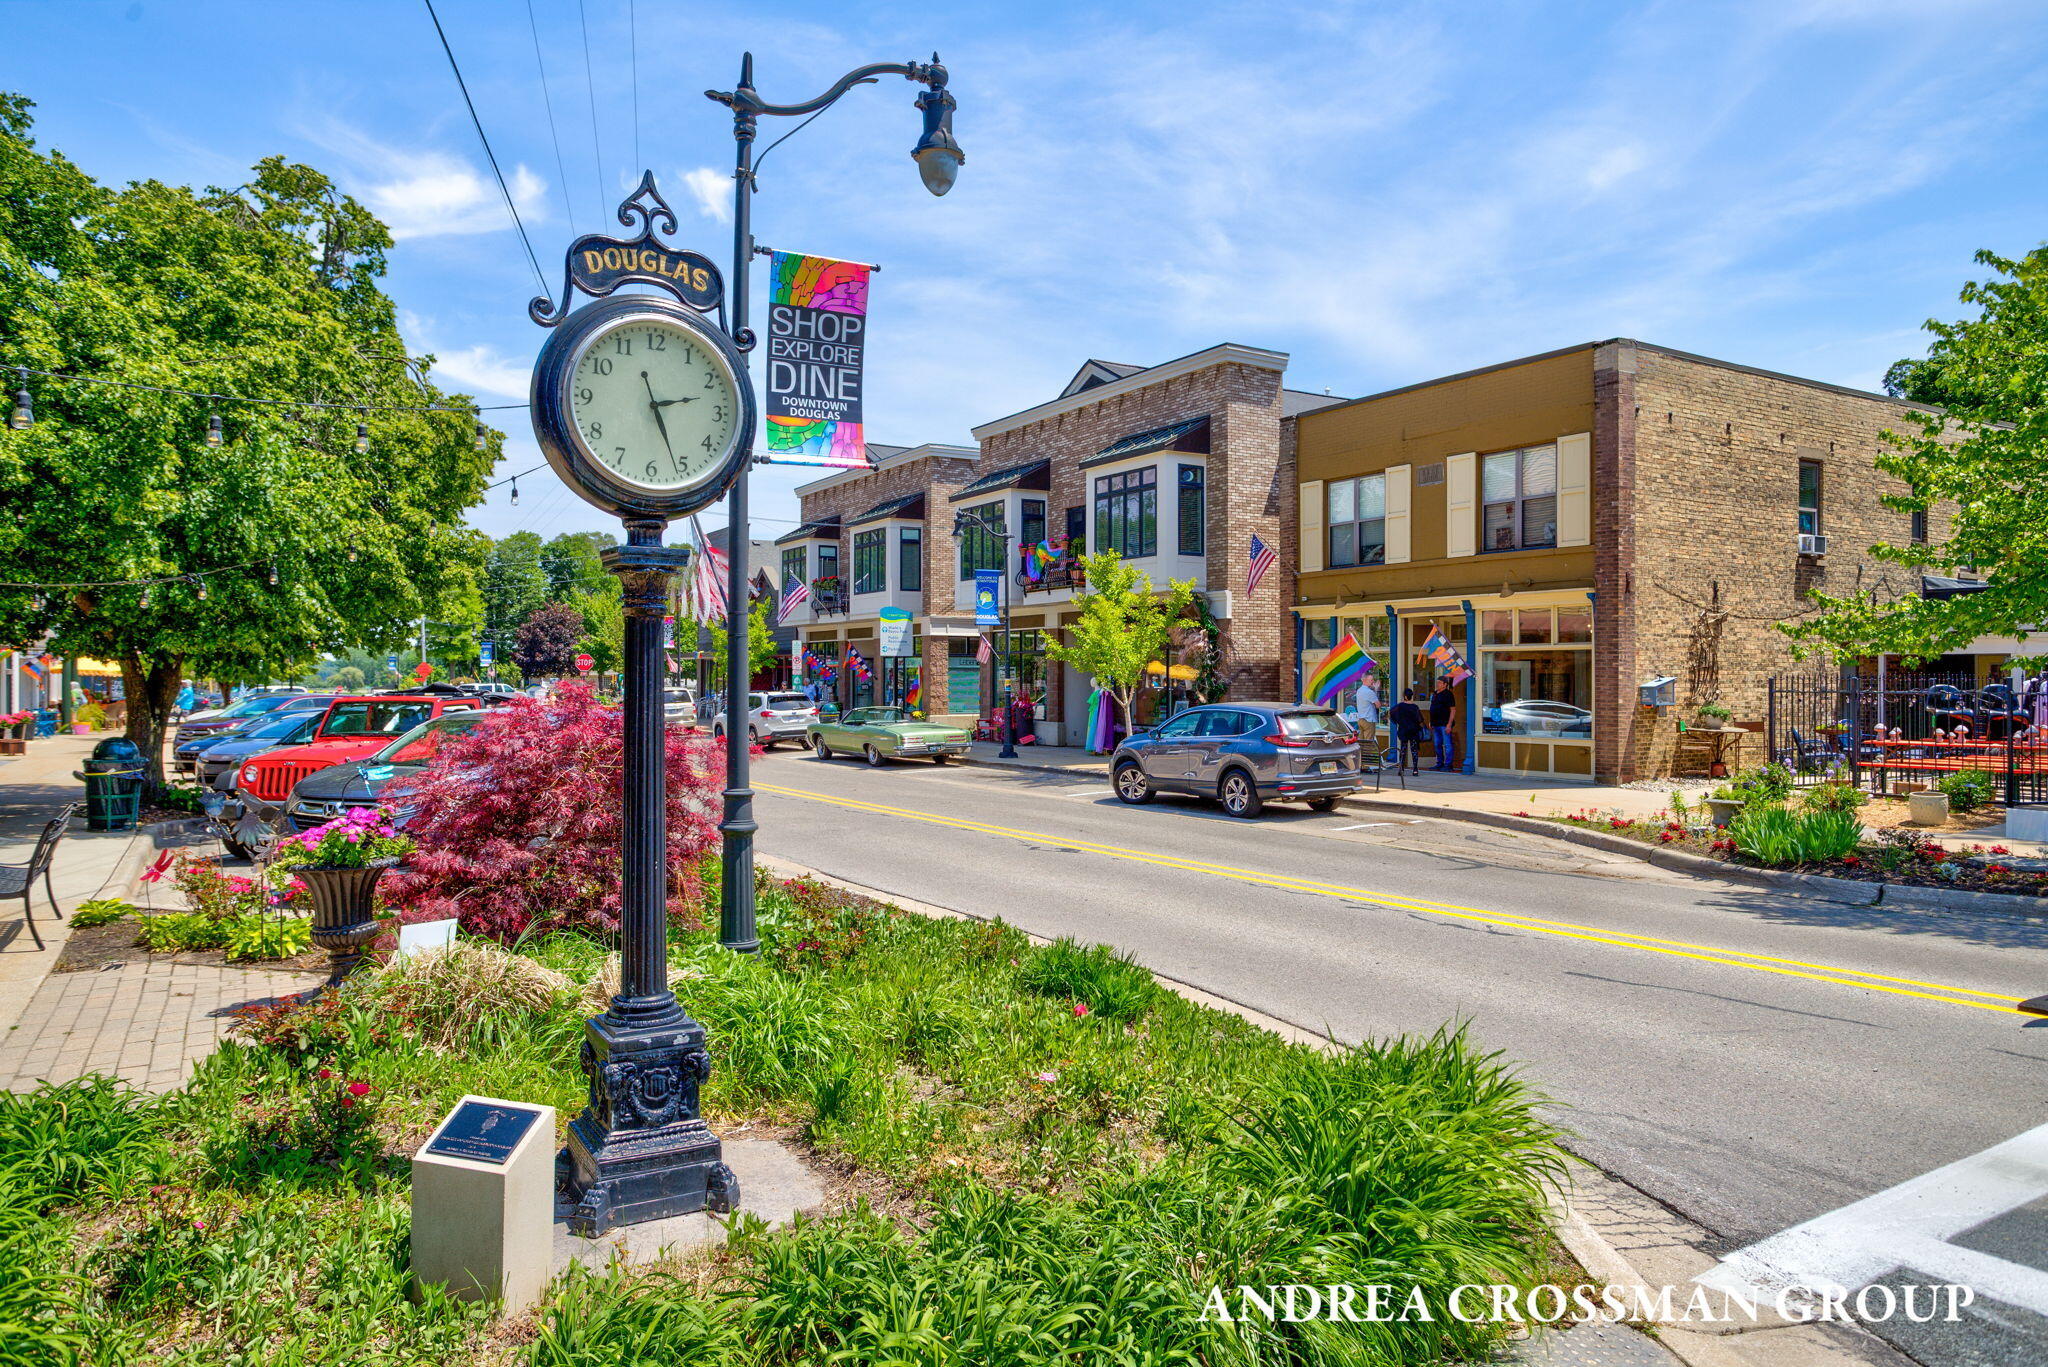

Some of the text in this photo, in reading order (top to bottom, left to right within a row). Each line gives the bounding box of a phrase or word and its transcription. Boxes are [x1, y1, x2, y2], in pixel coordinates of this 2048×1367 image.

[583, 248, 710, 292] DOUGLAS
[772, 306, 862, 343] SHOP
[615, 337, 633, 356] 11
[646, 333, 666, 352] 12
[684, 347, 693, 365] 1
[771, 338, 860, 366] EXPLORE
[592, 357, 613, 376] 10
[704, 372, 715, 390] 2
[771, 360, 859, 401] DINE
[580, 388, 593, 405] 9
[782, 396, 848, 412] DOWNTOWN
[711, 405, 723, 422] 3
[789, 407, 841, 420] DOUGLAS
[590, 422, 602, 440] 8
[701, 434, 713, 453] 4
[615, 447, 626, 465] 7
[678, 455, 688, 473] 5
[645, 460, 658, 477] 6
